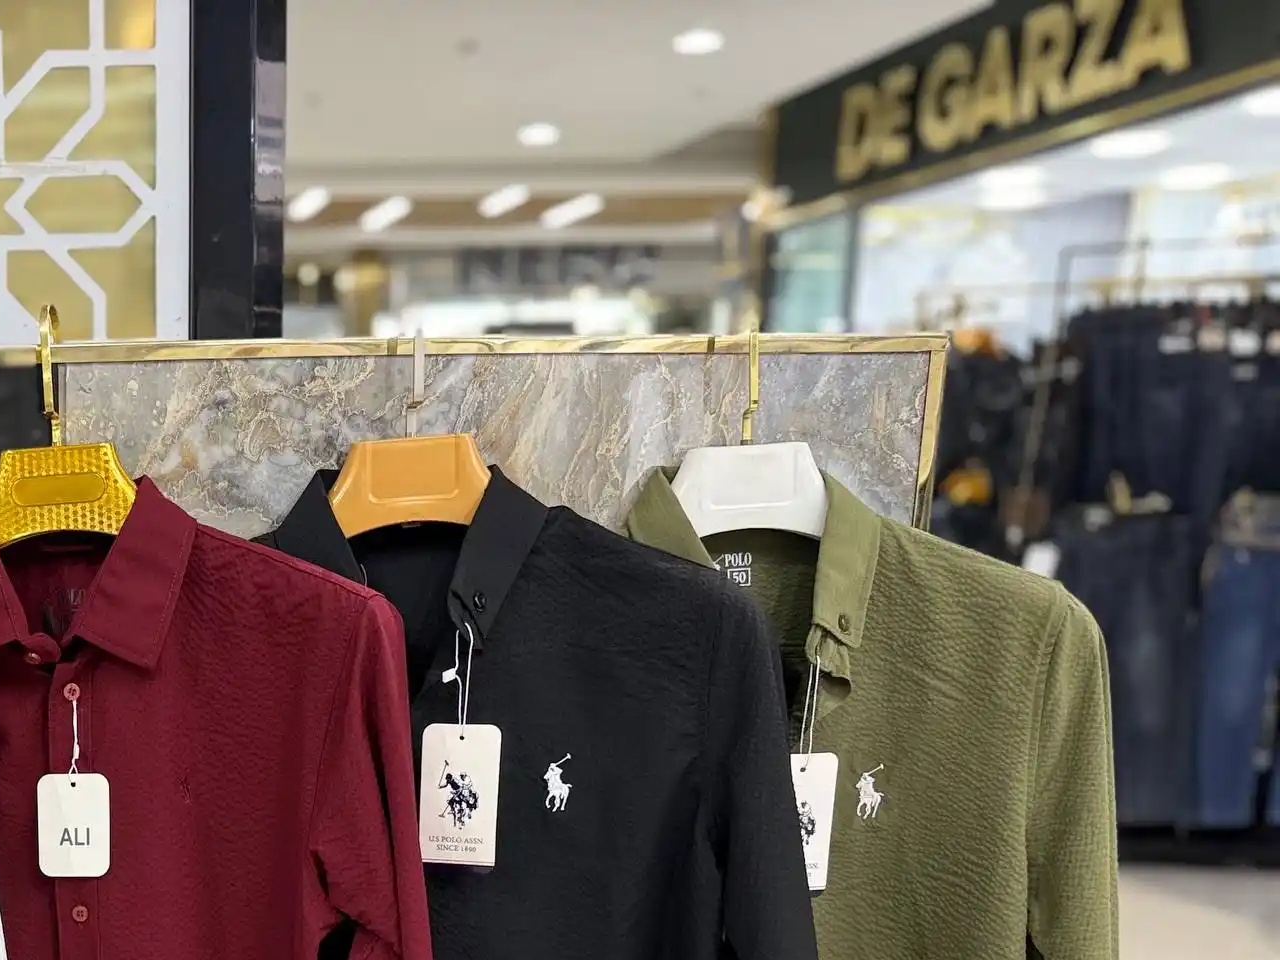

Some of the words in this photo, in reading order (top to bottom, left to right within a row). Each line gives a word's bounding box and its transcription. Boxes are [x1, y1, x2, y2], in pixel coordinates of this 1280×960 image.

[836, 65, 916, 181] DE
[918, 0, 1190, 150] GARZA
[724, 552, 752, 567] POLO
[732, 571, 747, 583] 50
[59, 827, 90, 846] ALI
[441, 836, 462, 844] POLO
